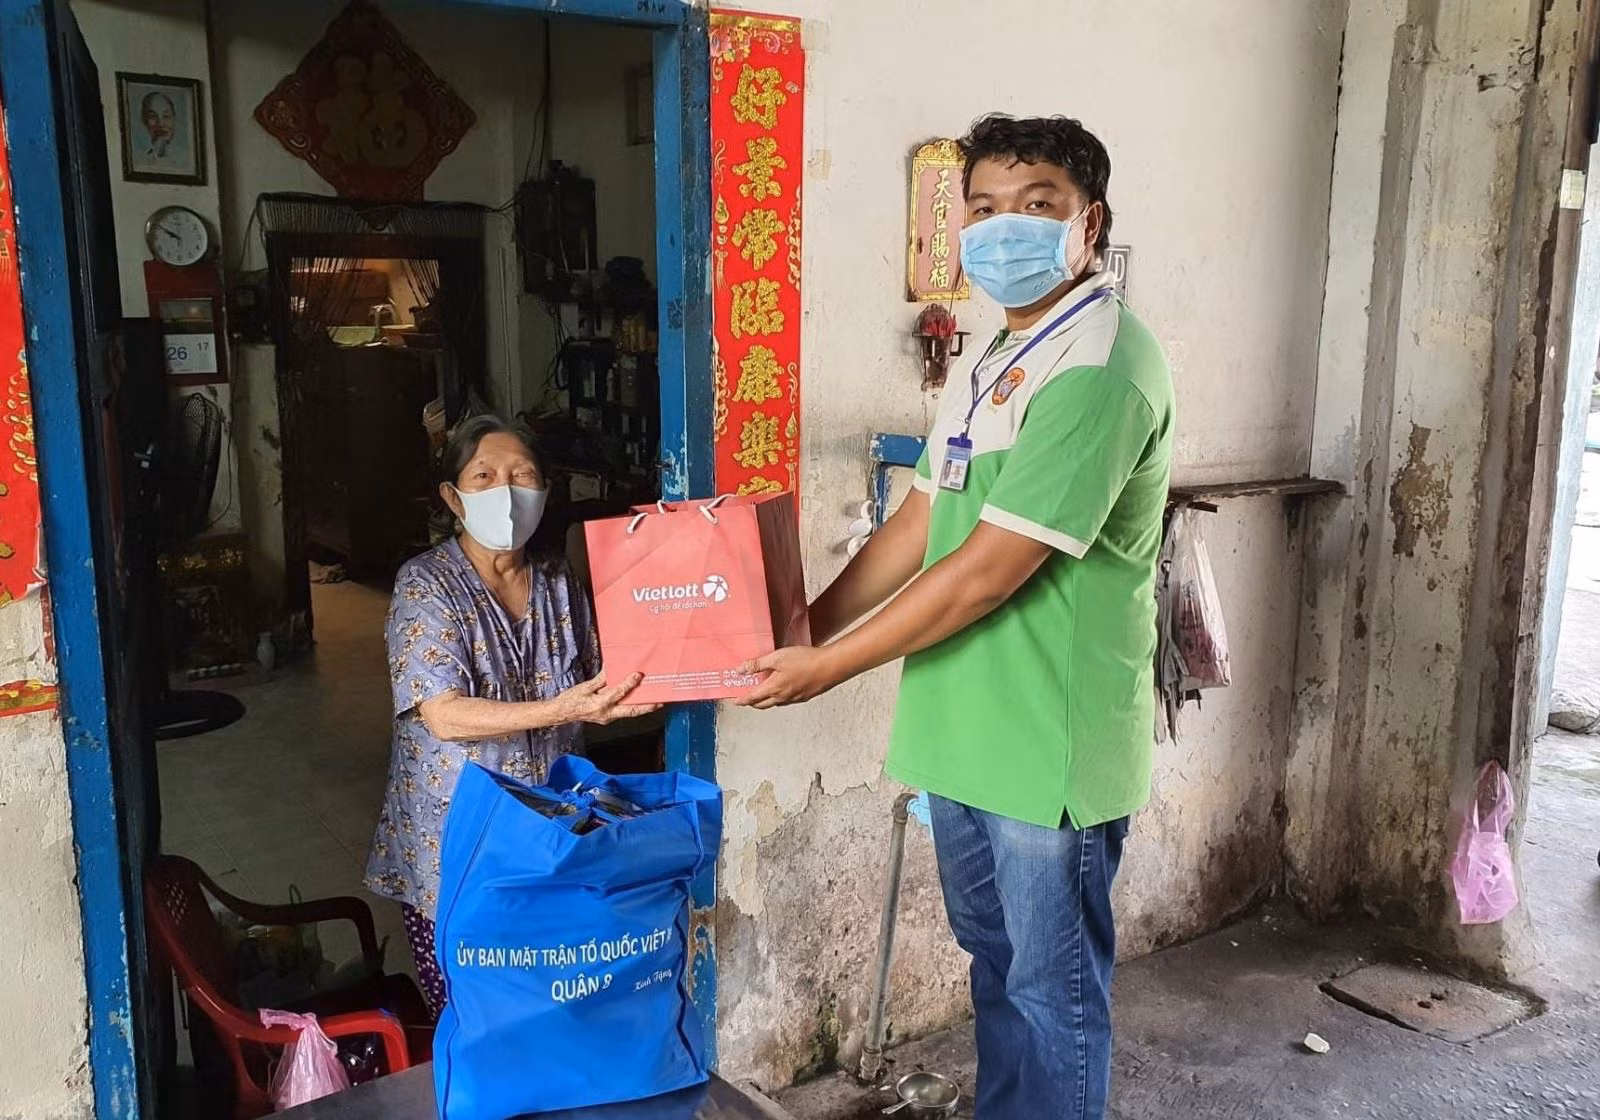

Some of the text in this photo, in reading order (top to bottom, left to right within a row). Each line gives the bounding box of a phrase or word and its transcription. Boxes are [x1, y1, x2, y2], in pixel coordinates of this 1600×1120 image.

[928, 169, 954, 288] 天官賜福
[167, 346, 188, 360] 26
[632, 583, 699, 602] Vietlott
[457, 942, 474, 967] ỦY
[479, 948, 505, 967] BAN
[510, 946, 538, 970] MẶT
[541, 946, 576, 969] TRẬN
[600, 932, 638, 963] QUỐC
[551, 973, 599, 1003] QUẬN
